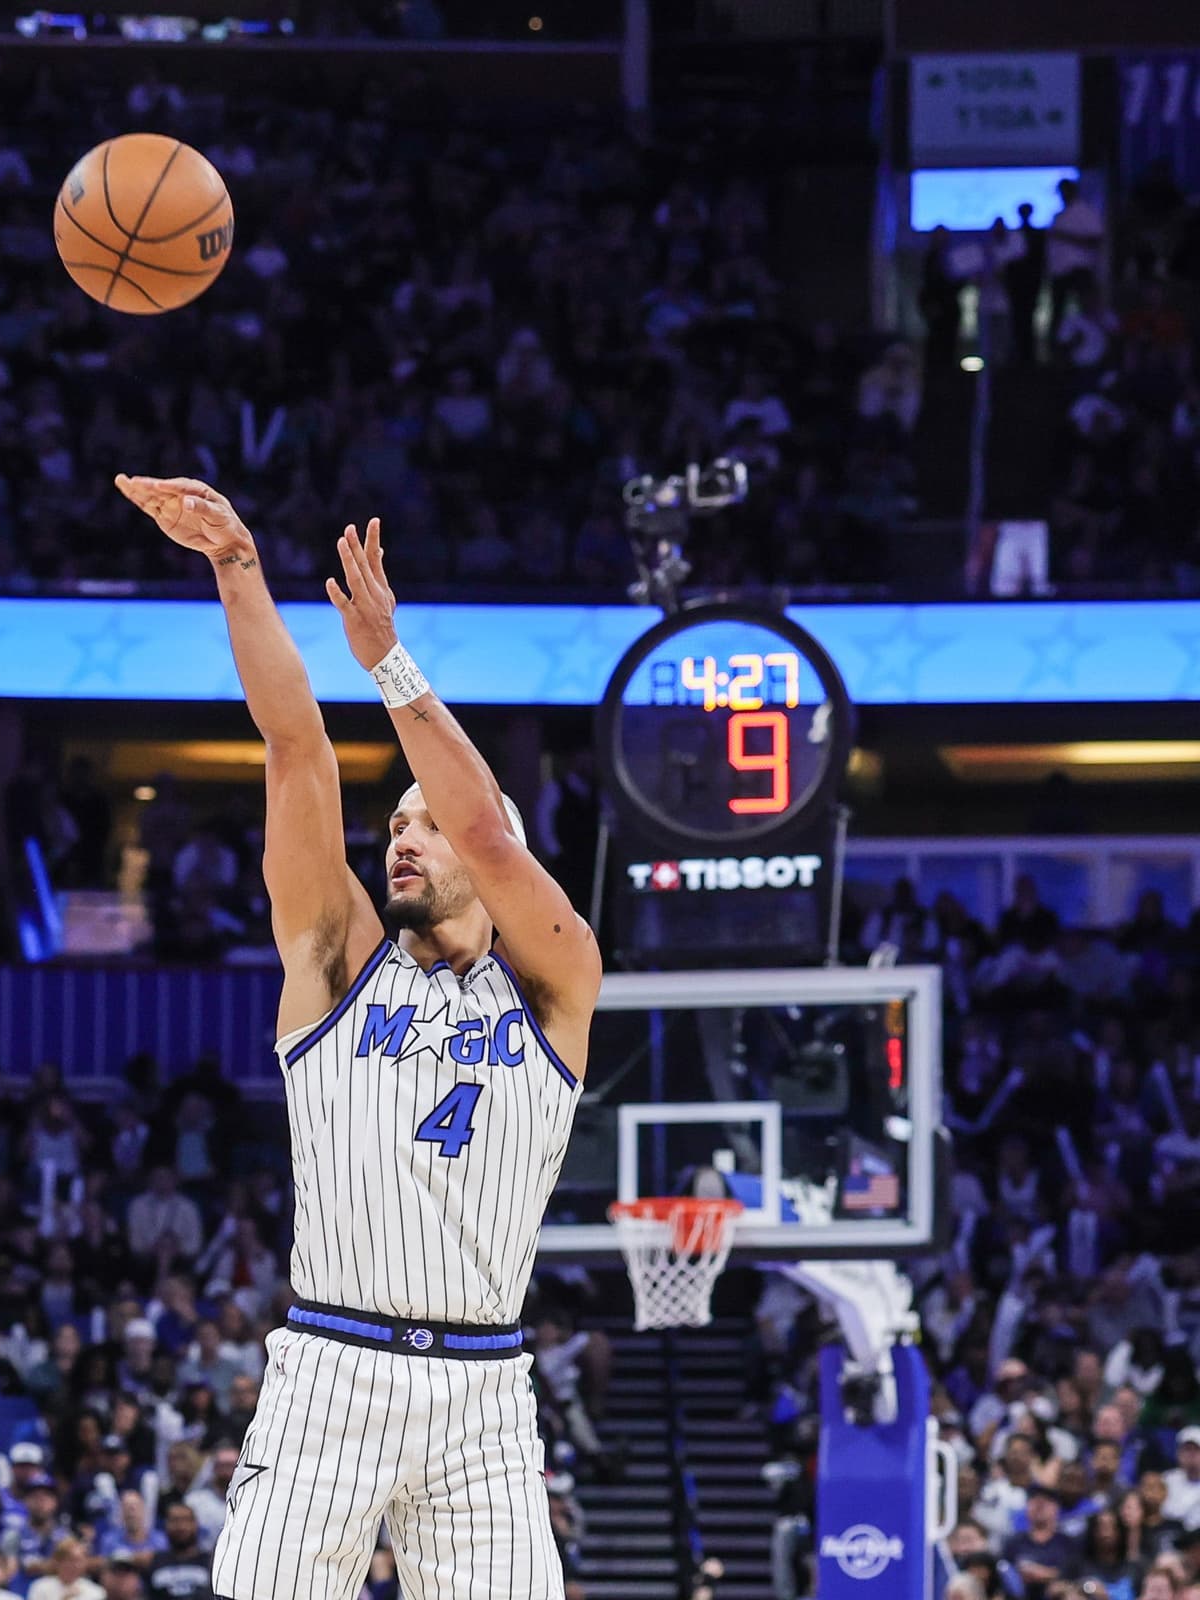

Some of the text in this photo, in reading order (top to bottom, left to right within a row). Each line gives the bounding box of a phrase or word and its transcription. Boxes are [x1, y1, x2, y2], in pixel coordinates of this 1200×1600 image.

[682, 653, 799, 712] 4:27
[728, 711, 790, 815] 9
[414, 1082, 485, 1159] 4
